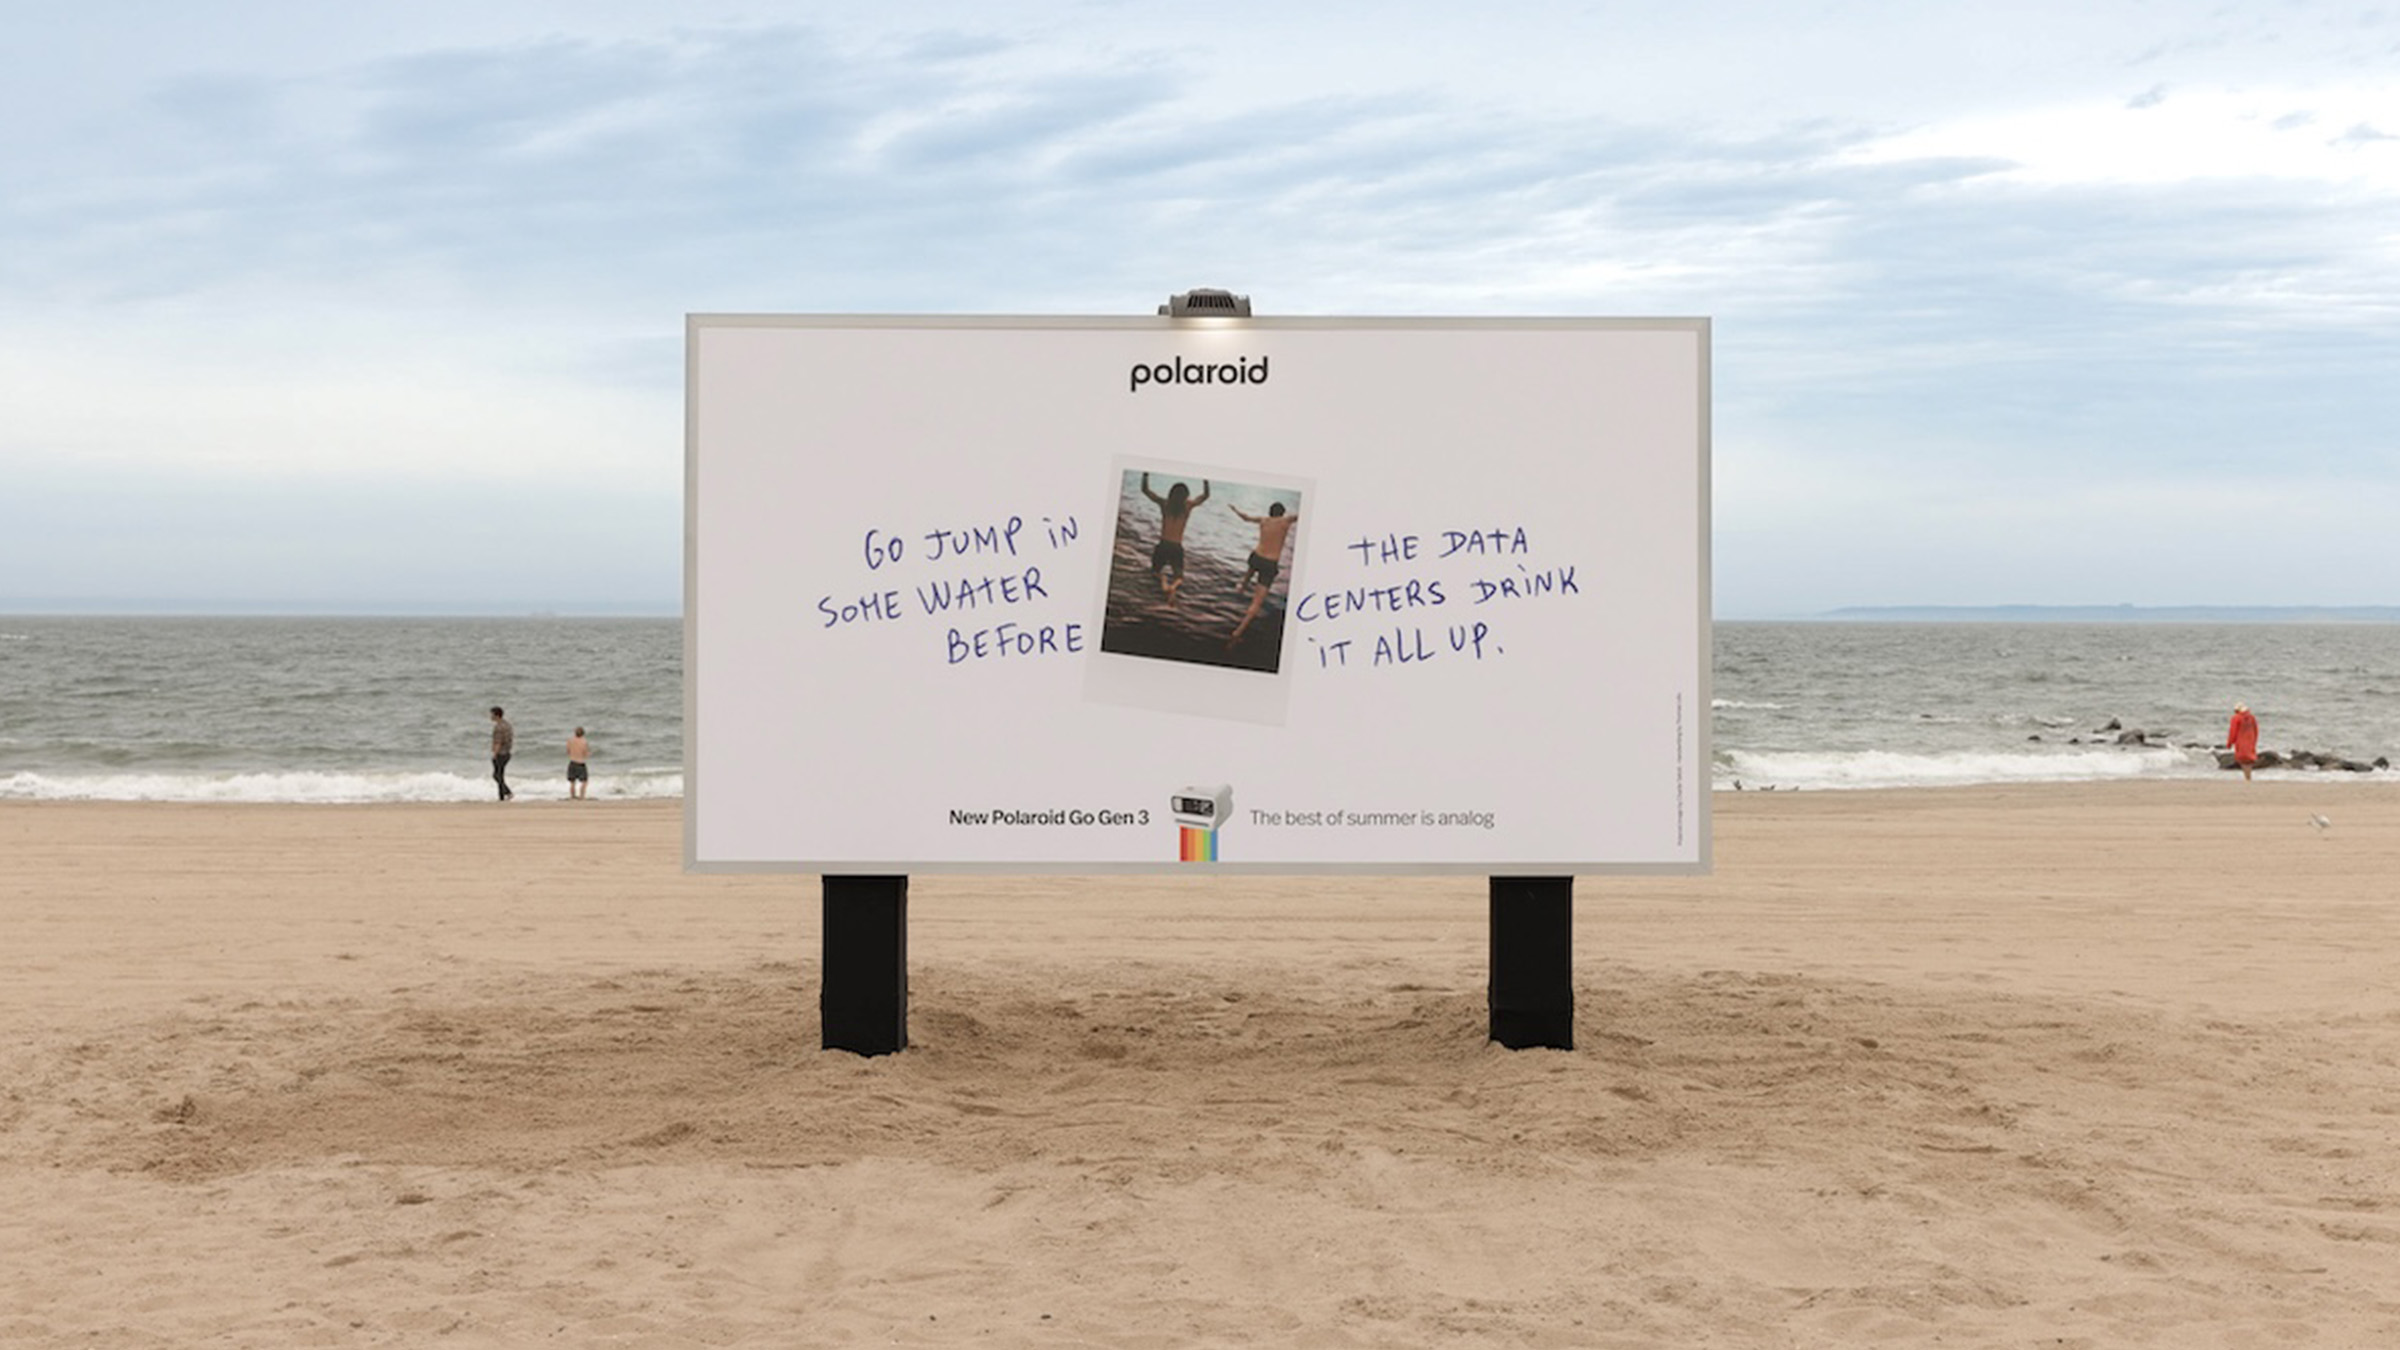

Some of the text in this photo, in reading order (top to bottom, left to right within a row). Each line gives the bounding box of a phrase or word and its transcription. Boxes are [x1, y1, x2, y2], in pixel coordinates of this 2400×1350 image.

[1130, 356, 1269, 392] polaroid
[864, 529, 904, 571] GO
[924, 515, 1023, 561] JUMP
[1347, 526, 1529, 566] THE DATA
[817, 566, 1048, 629] SOME WATER
[1295, 578, 1446, 623] CENTERS
[947, 622, 1084, 665] BEFORE
[1373, 627, 1436, 667] ALL
[1449, 621, 1504, 660] UP.
[949, 808, 1150, 826] New Polaroid Go Gen 3
[1249, 809, 1495, 831] The best of summer is analog
